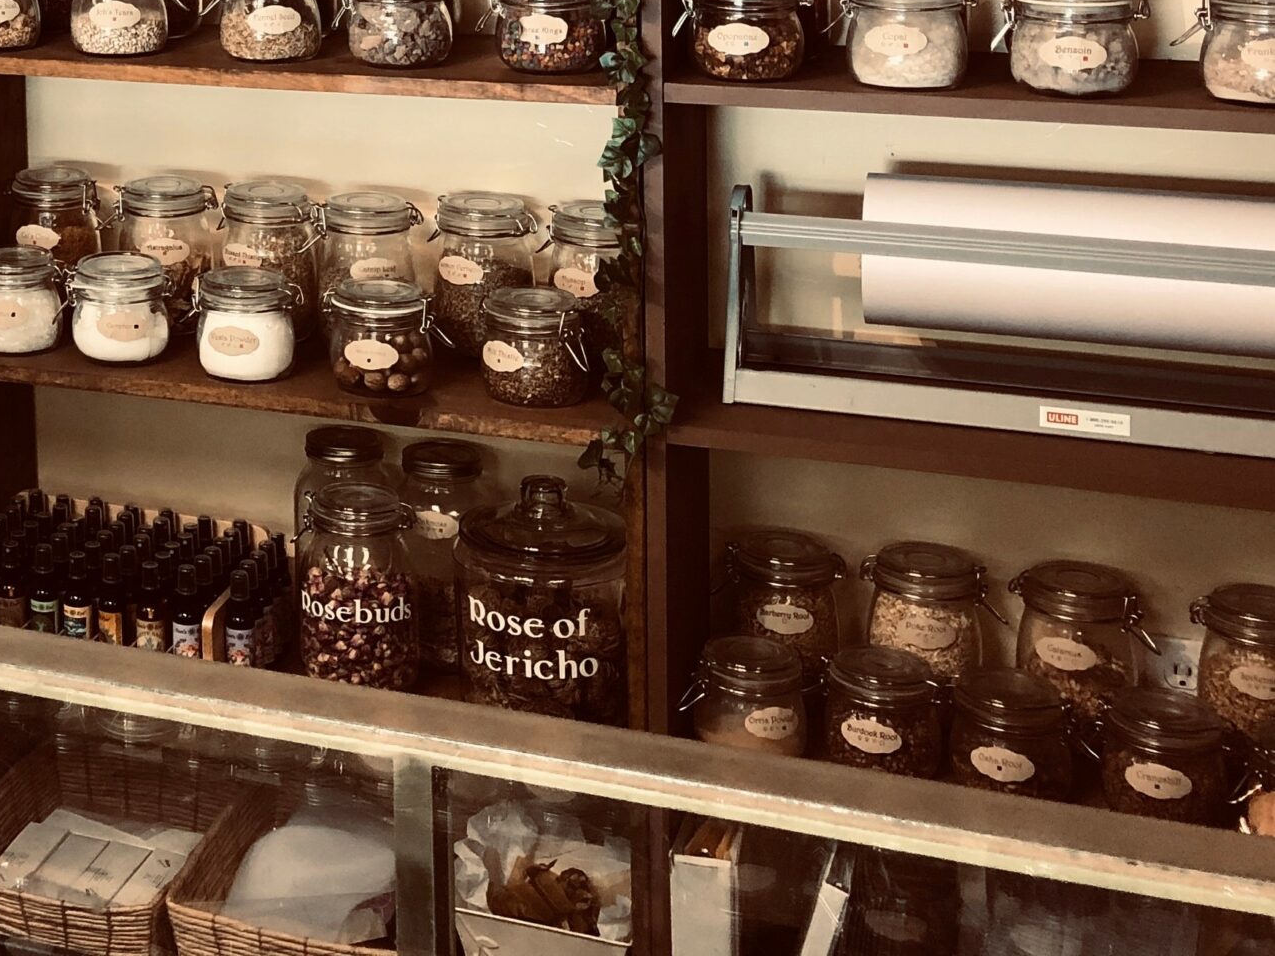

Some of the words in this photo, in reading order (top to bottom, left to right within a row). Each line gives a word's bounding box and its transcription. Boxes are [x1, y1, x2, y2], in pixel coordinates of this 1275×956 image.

[1047, 412, 1078, 424] ULINE
[301, 589, 412, 625] Rosebuds
[467, 594, 545, 639] Rose
[552, 607, 592, 638] of
[470, 639, 599, 681] Jericho
